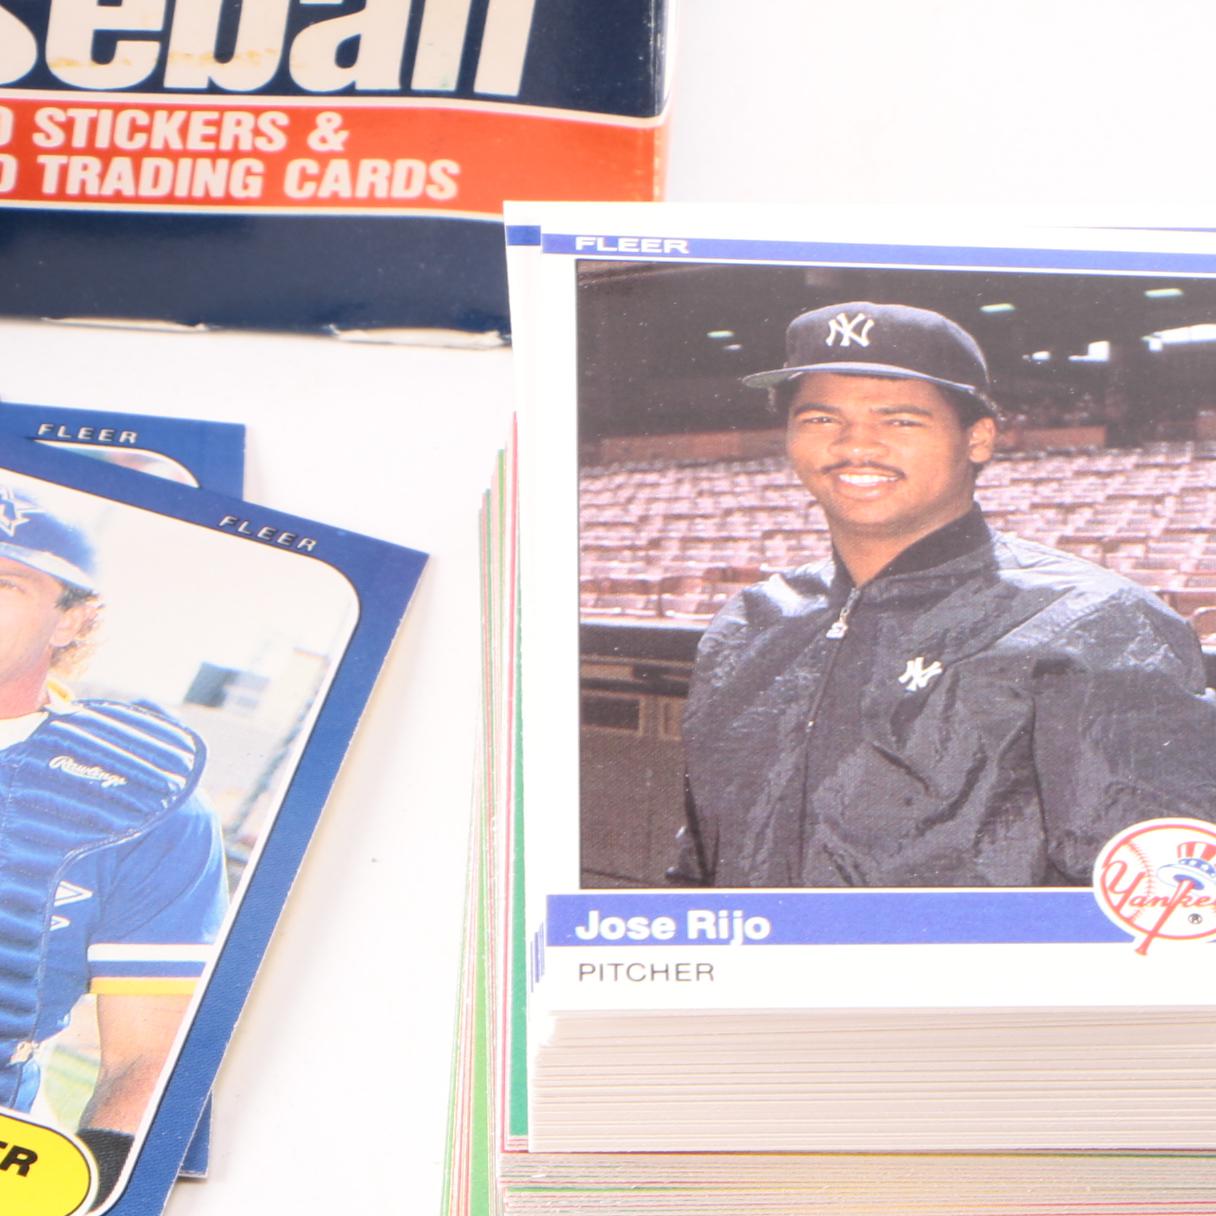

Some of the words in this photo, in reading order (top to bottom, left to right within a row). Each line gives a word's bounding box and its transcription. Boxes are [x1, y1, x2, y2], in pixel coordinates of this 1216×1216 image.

[32, 107, 290, 152] STICKERS
[308, 112, 350, 152] &
[37, 154, 265, 198] TRADING
[283, 158, 460, 200] CARDS
[575, 236, 689, 254] FLEER
[37, 423, 138, 444] FLEER
[218, 515, 318, 552] FLEER
[575, 910, 676, 940] Jose
[687, 910, 771, 945] Rijo
[578, 962, 715, 982] PITCHER
